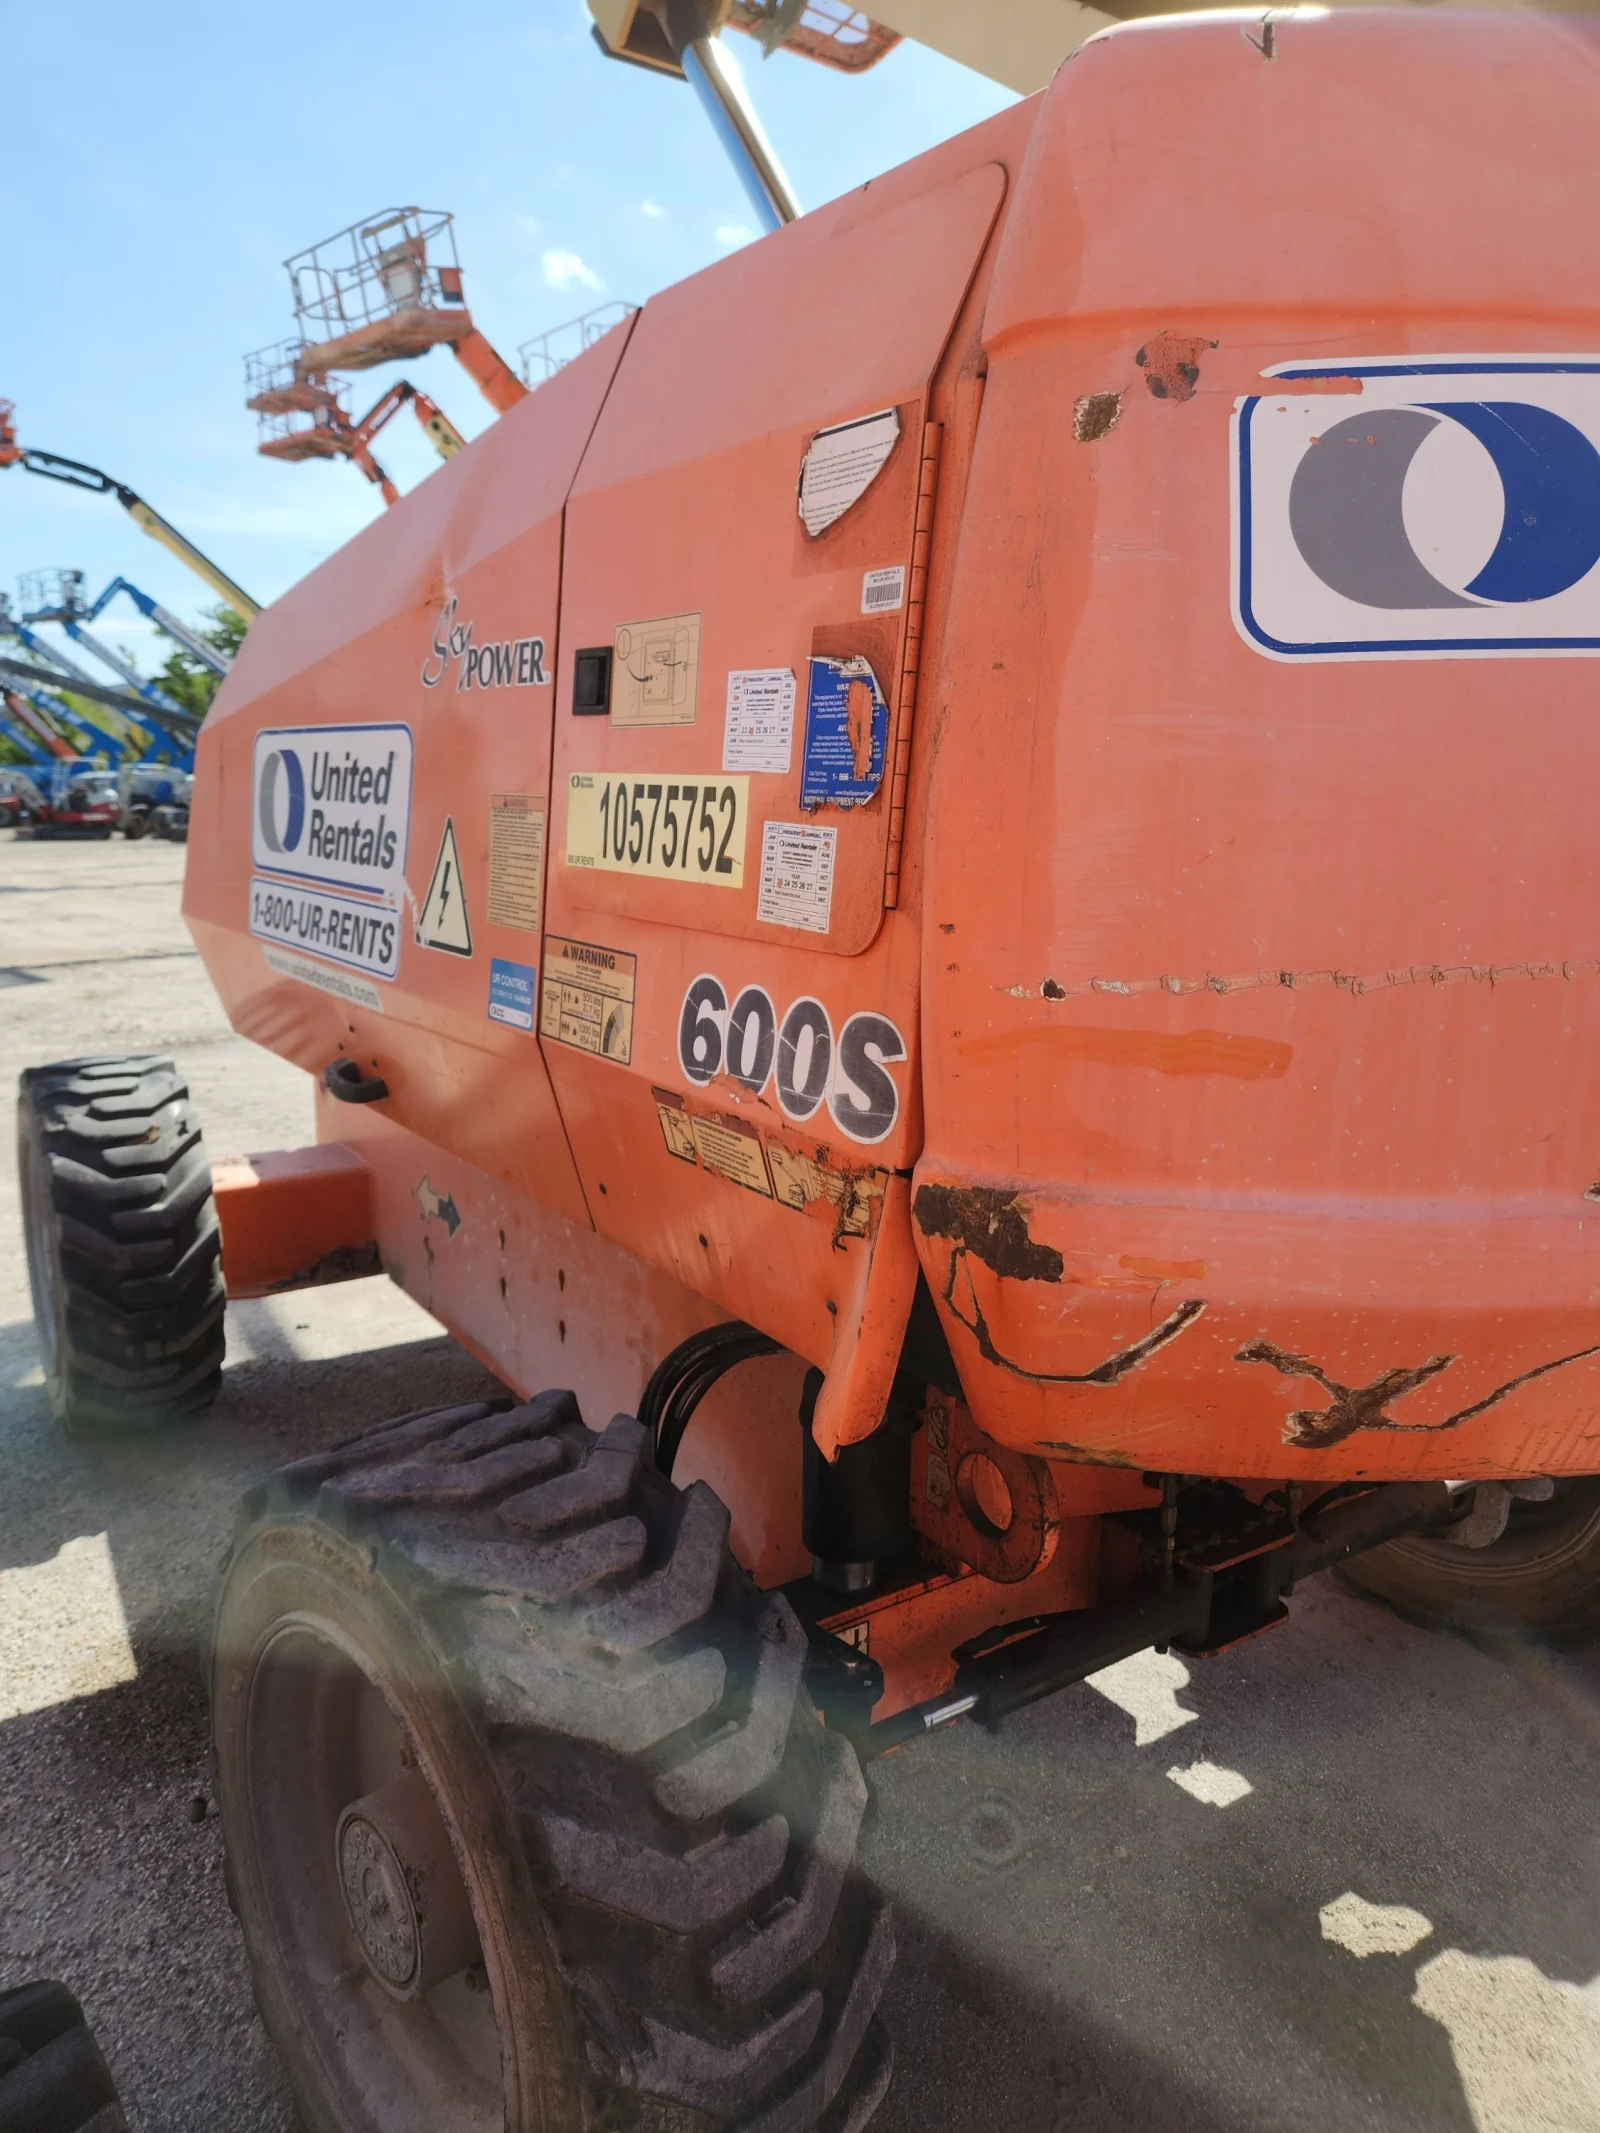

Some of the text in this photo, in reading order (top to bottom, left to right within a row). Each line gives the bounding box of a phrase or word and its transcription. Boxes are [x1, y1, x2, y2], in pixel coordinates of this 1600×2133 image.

[466, 639, 545, 688] POWER
[311, 750, 395, 805] United
[308, 809, 397, 869] Rentals
[600, 781, 736, 874] 10575752
[253, 891, 396, 964] 1-800-UR-RENTS
[500, 975, 529, 992] CONTROL
[570, 944, 616, 970] WARNING
[582, 992, 593, 1004] 500
[679, 975, 906, 1143] 600S
